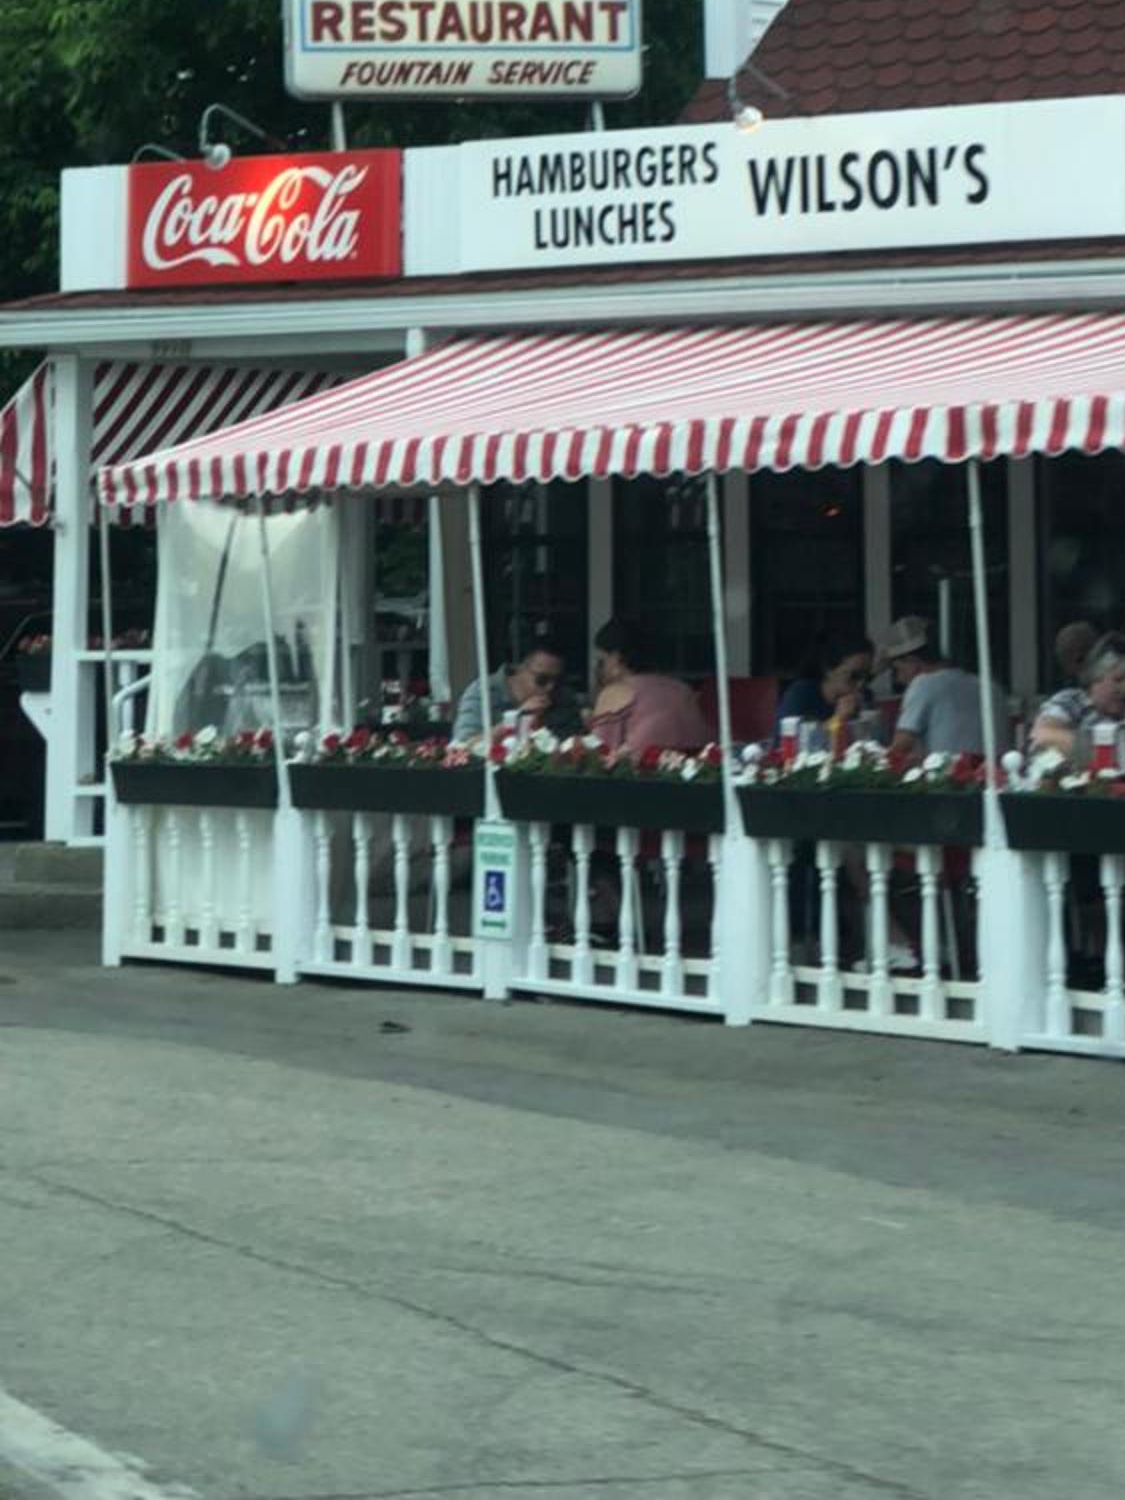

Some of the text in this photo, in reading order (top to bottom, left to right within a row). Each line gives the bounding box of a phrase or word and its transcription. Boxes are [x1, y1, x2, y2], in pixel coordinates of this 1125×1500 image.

[311, 1, 627, 43] RESTAURANT
[340, 60, 597, 86] FOUNTAIN SERVICE
[491, 141, 720, 198] HAMBURGERS
[748, 143, 990, 217] WILSON'S
[534, 201, 676, 250] LUNCHES
